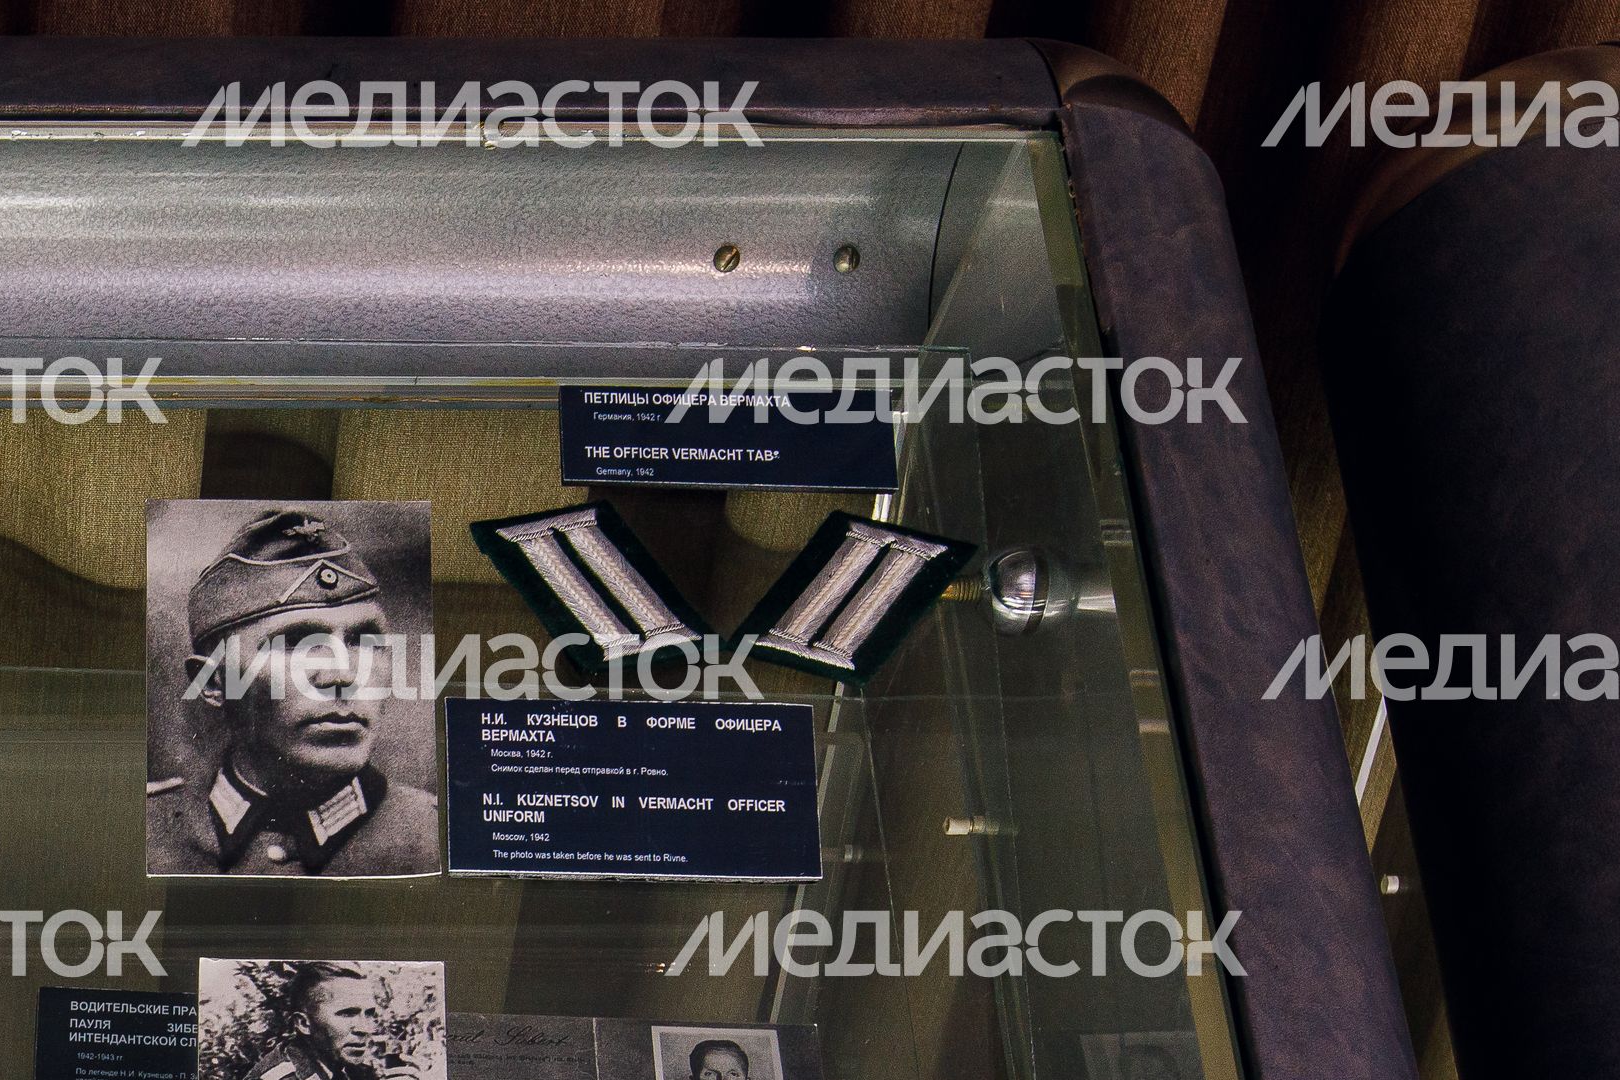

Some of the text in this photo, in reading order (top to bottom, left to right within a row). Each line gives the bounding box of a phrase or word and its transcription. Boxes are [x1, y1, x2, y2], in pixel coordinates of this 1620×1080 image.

[584, 392, 790, 408] ПЕТЛИЦЫ ОФИЦЕРА ВЕРМАХТА
[636, 412, 655, 421] 1942
[585, 446, 609, 458] THE
[613, 447, 668, 459] OFFICER
[672, 448, 743, 461] VERMACHT
[596, 467, 654, 477] Germany, 1942
[481, 713, 507, 725] Н.И.
[527, 714, 598, 728] КУЗНЕЦОВ
[646, 717, 696, 729] ФОРМЕ
[715, 719, 781, 733] ОФИЦЕРА
[482, 730, 555, 742] ВЕРМАХТА
[491, 749, 546, 758] Москва, 1942
[491, 764, 523, 773] Снимок
[524, 765, 554, 774] сделан
[582, 767, 624, 775] отправкой
[641, 767, 669, 776] Ровно.
[483, 793, 786, 812] N.I. KUZNETSOV IN VERMACHT OFFICER
[483, 810, 545, 823] UNIFORM
[493, 832, 528, 842] Moscow,
[493, 850, 508, 858] The
[510, 851, 533, 859] photo
[553, 852, 574, 860] taken
[577, 852, 602, 860] before
[663, 854, 688, 862] Rivne.
[70, 1001, 169, 1015] ВОДИТЕЛЬСКИЕ
[69, 1019, 111, 1029] ПАУЛЯ
[69, 1032, 177, 1046] ИНТЕНДАНТСКОЙ
